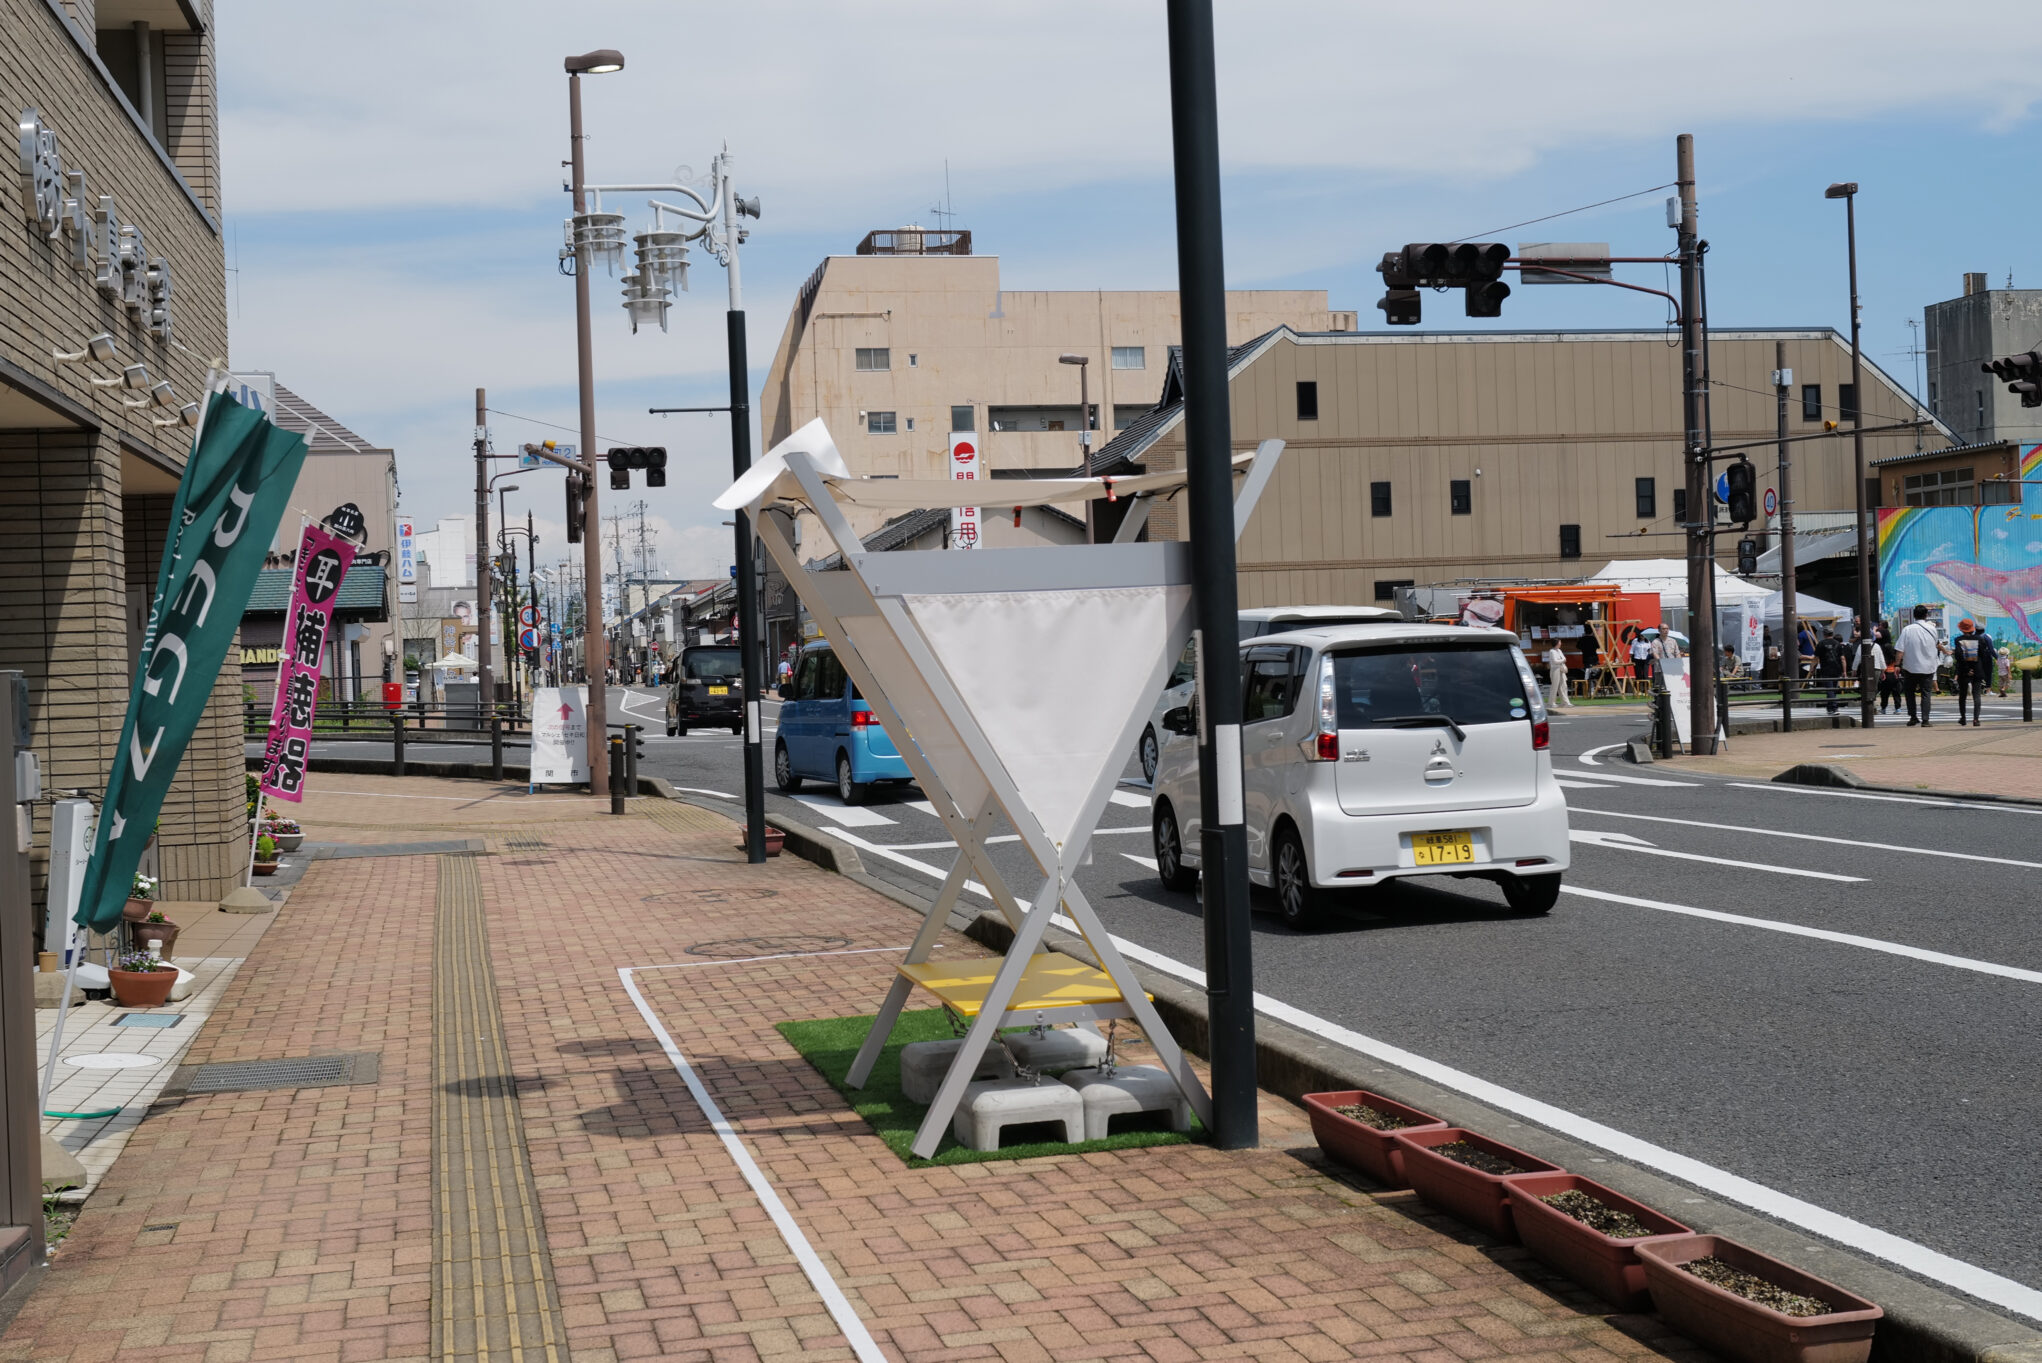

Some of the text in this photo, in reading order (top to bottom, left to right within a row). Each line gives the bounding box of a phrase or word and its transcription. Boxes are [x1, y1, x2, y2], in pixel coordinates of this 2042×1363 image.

[1766, 495, 1775, 508] 40
[306, 555, 339, 601] 耳
[1429, 844, 1471, 862] 17-19
